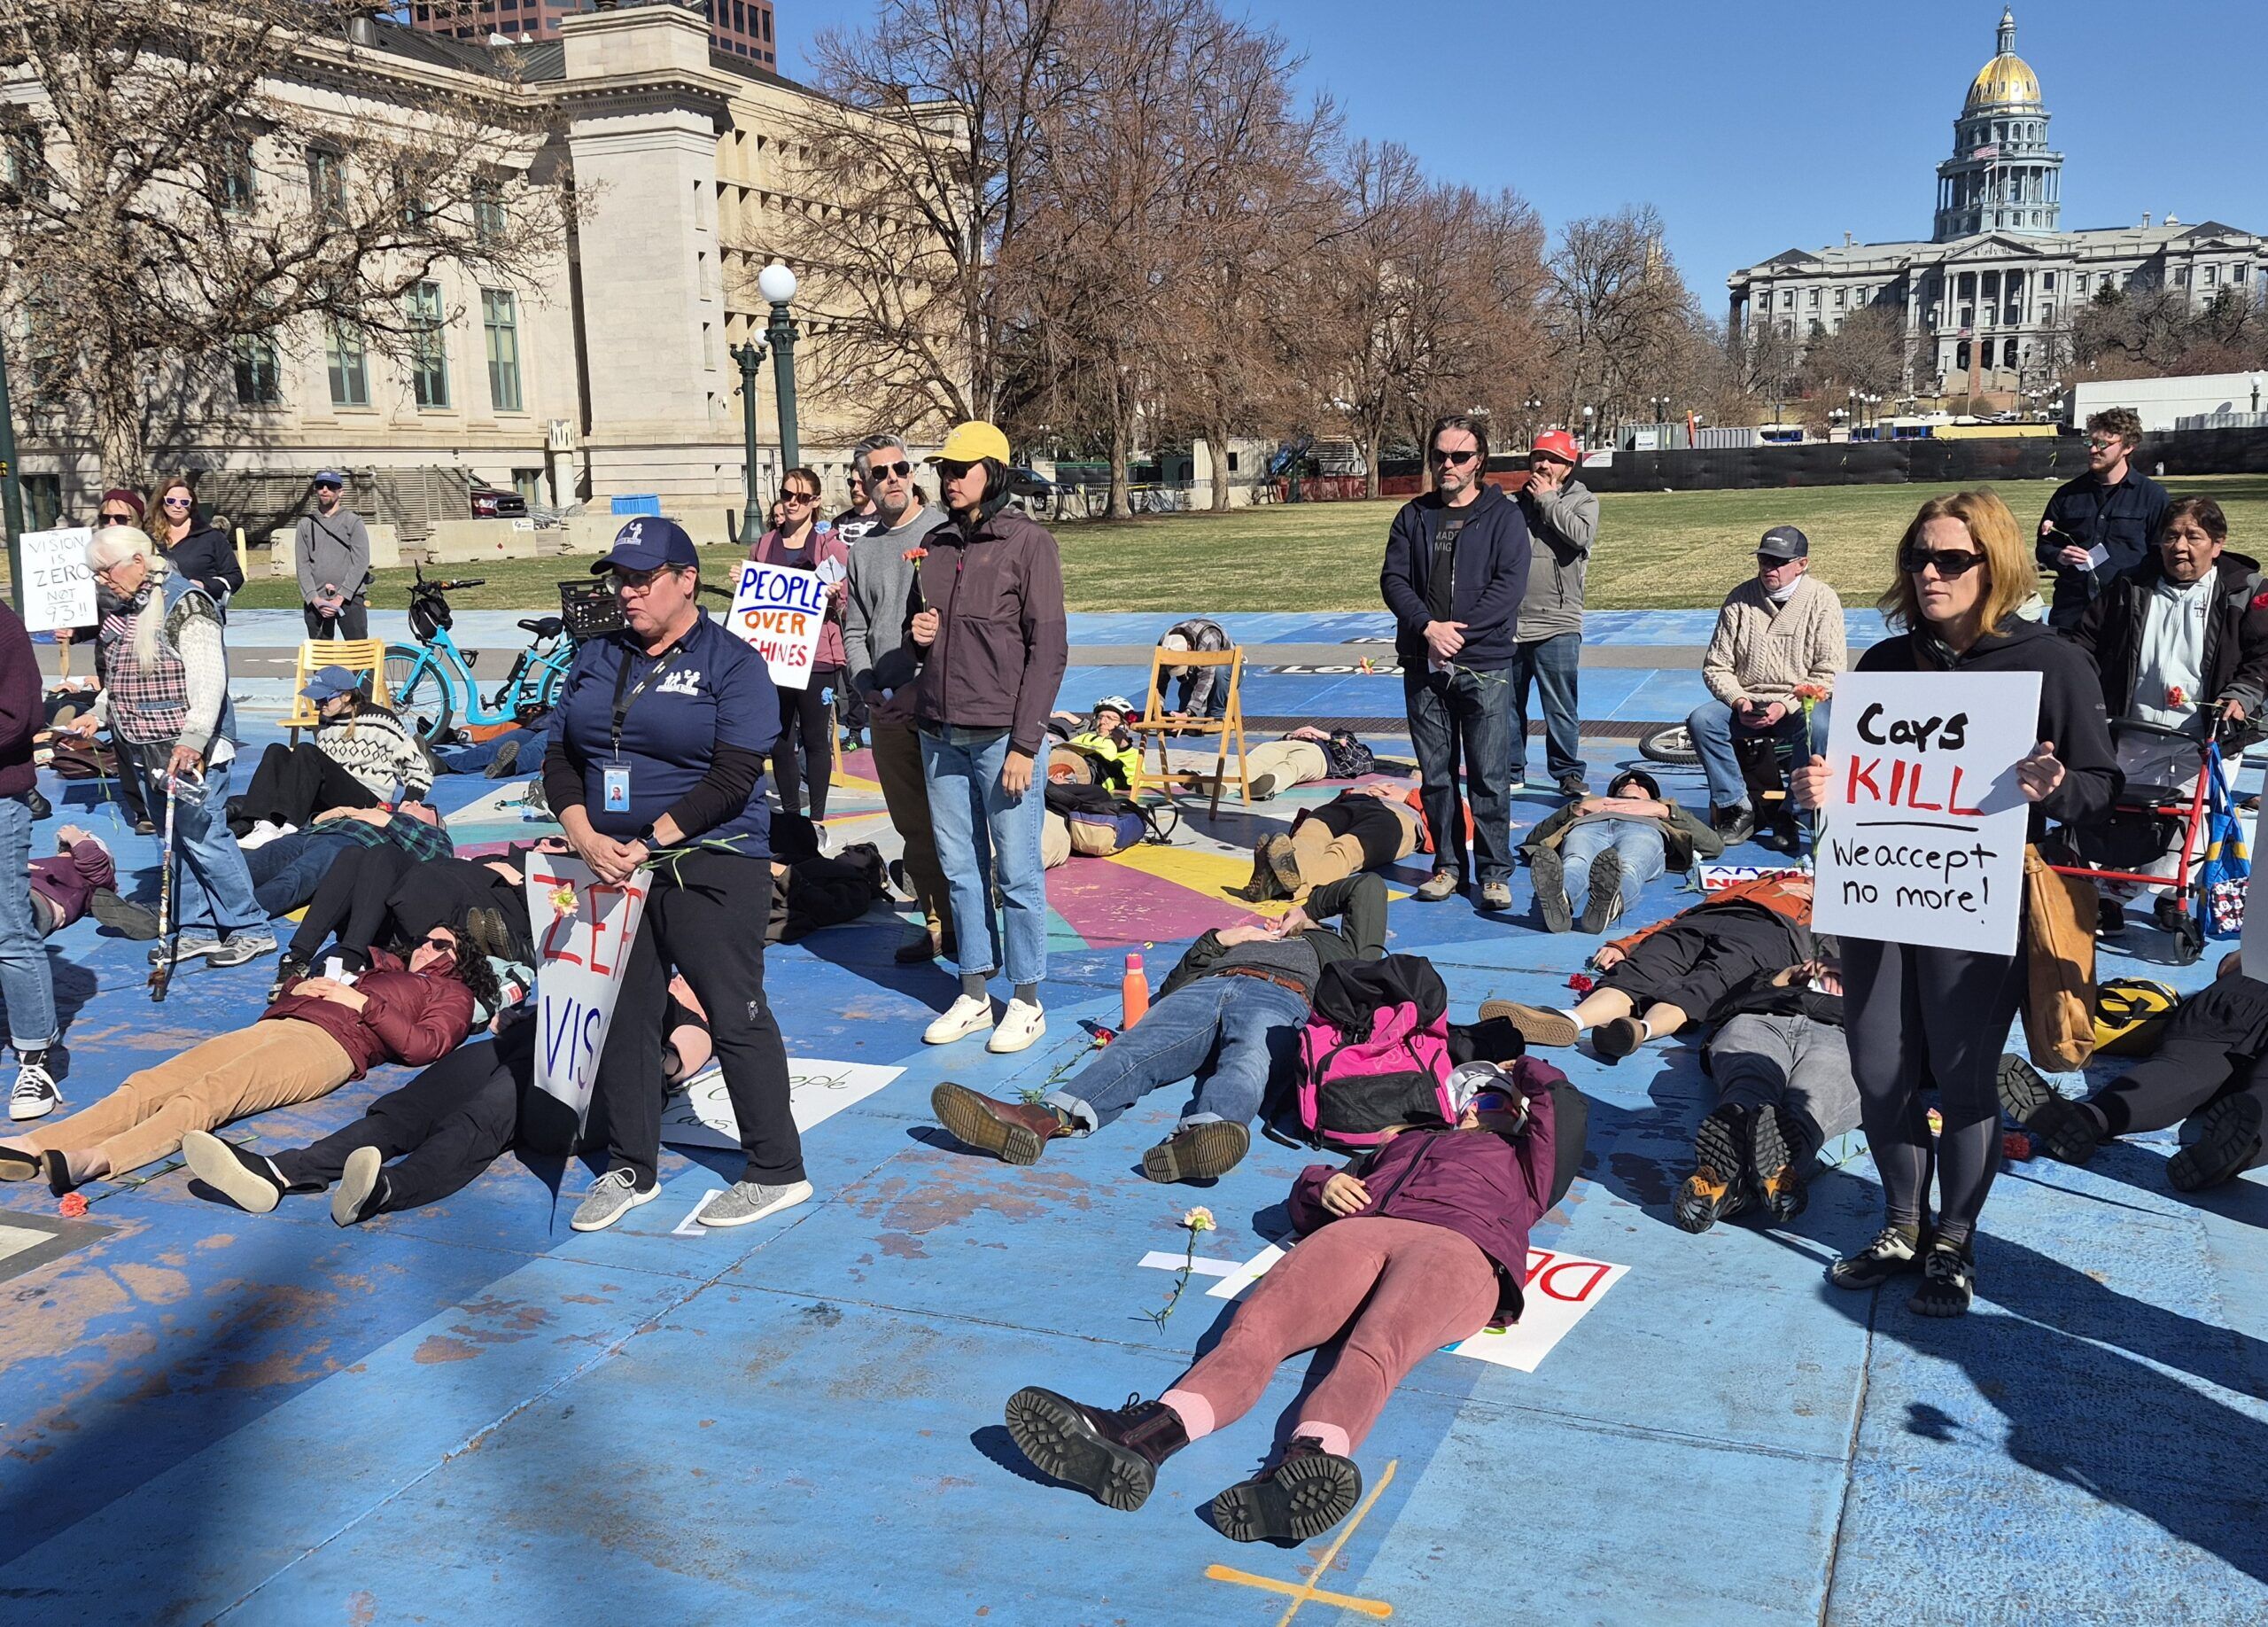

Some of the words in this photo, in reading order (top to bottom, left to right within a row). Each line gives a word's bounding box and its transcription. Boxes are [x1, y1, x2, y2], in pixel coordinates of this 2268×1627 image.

[28, 535, 84, 553] VISION
[1434, 542, 1452, 552] MIG
[51, 554, 66, 564] IS
[33, 563, 91, 587] ZERO
[739, 568, 827, 611] PEOPLE
[744, 611, 806, 636] OVER
[1847, 754, 1985, 817] KILL
[1843, 880, 1878, 906] no
[1896, 876, 1989, 925] more!
[546, 995, 602, 1091] VIS
